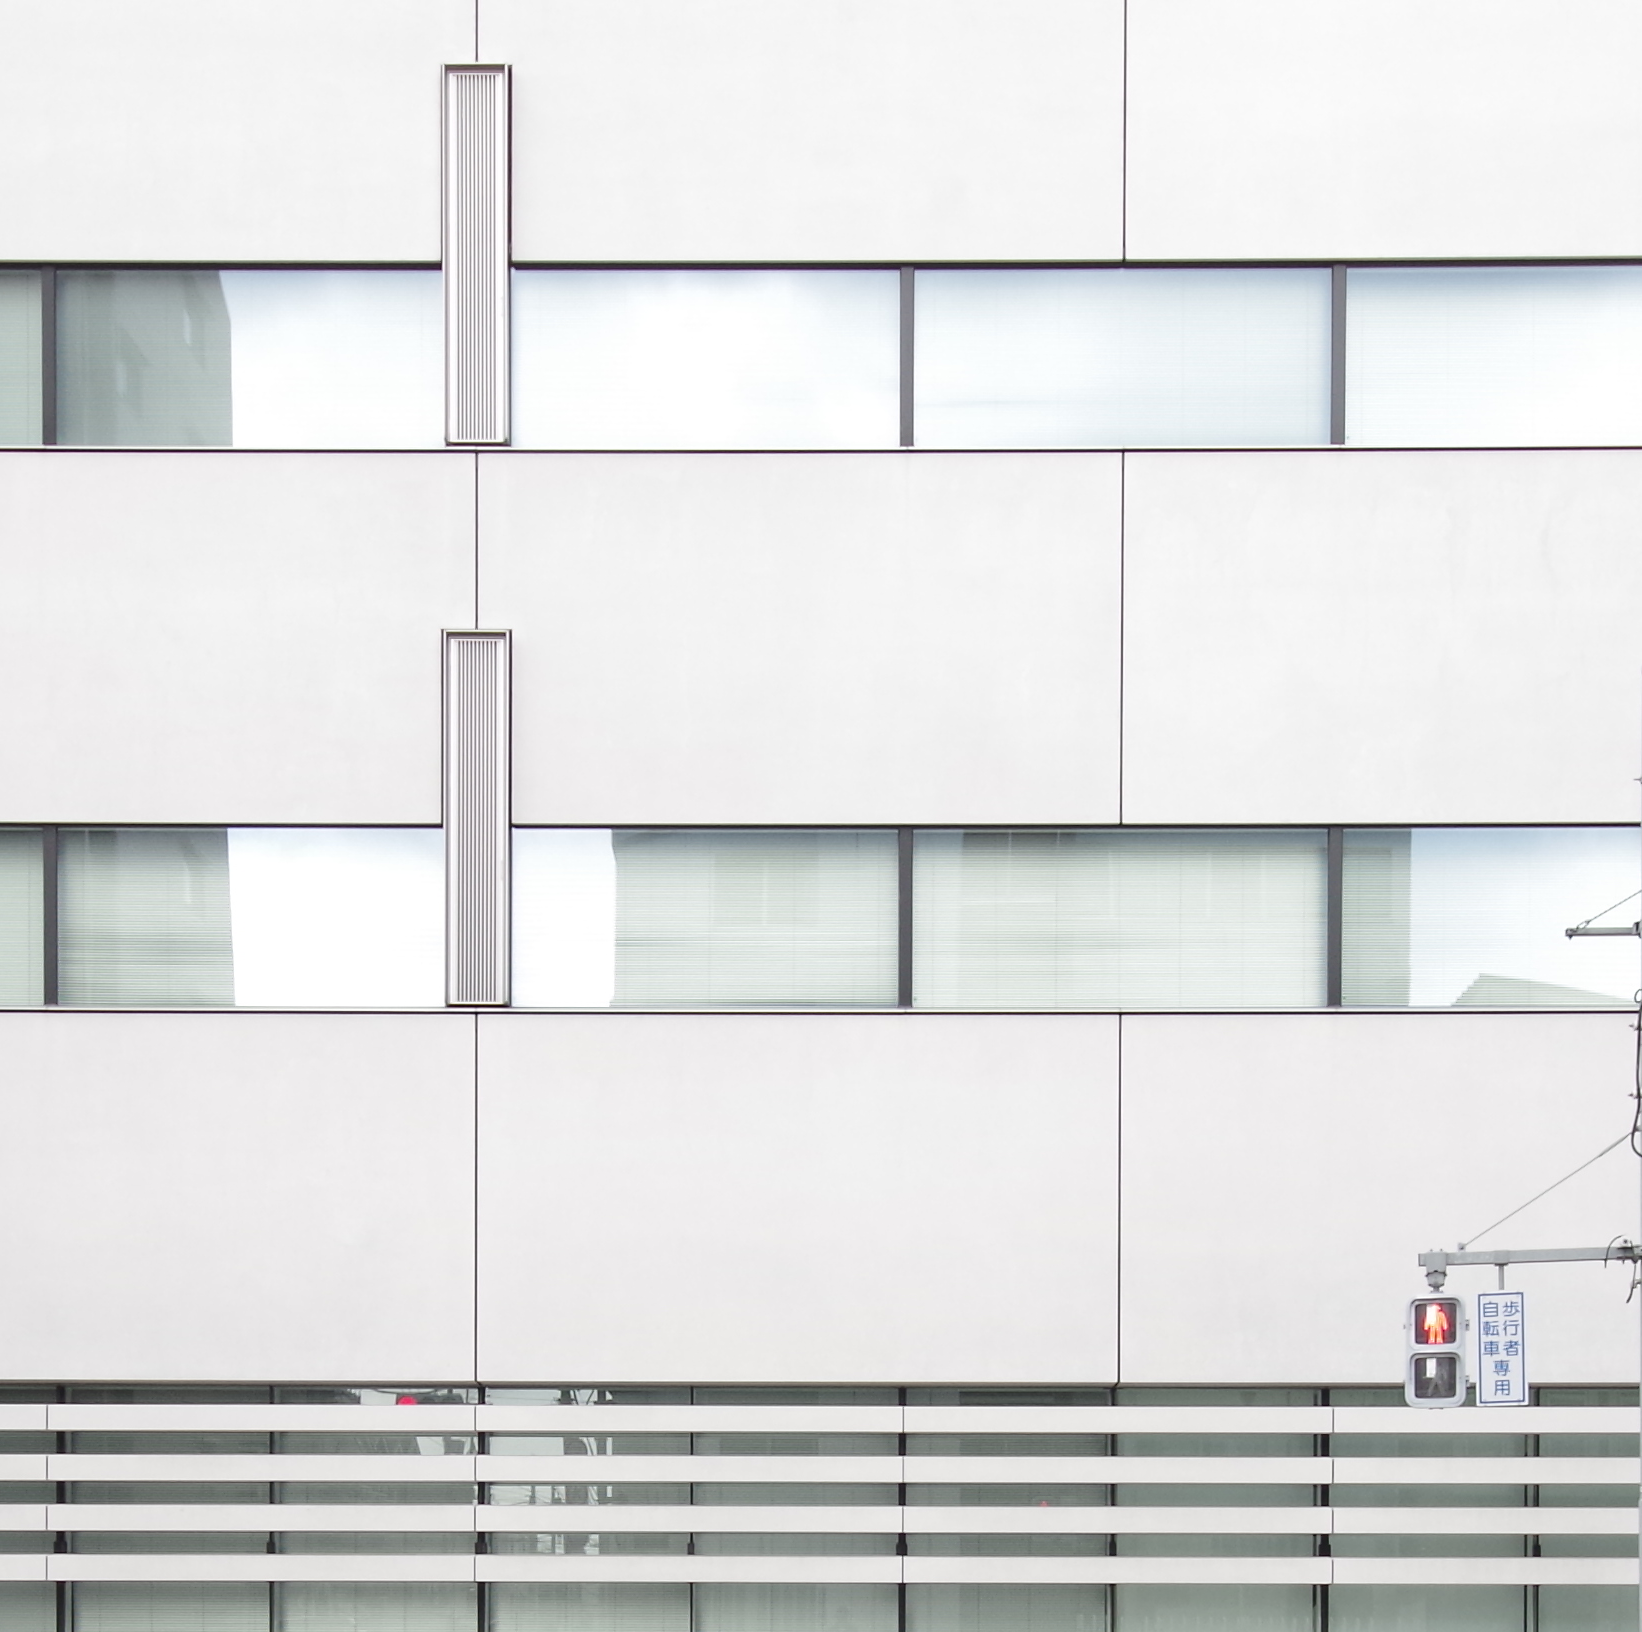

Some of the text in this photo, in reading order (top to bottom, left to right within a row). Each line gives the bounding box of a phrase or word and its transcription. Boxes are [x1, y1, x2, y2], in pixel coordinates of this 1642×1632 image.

[1482, 1301, 1500, 1356] 自転車
[1503, 1301, 1520, 1356] 歩行者
[1493, 1360, 1510, 1395] 専用
